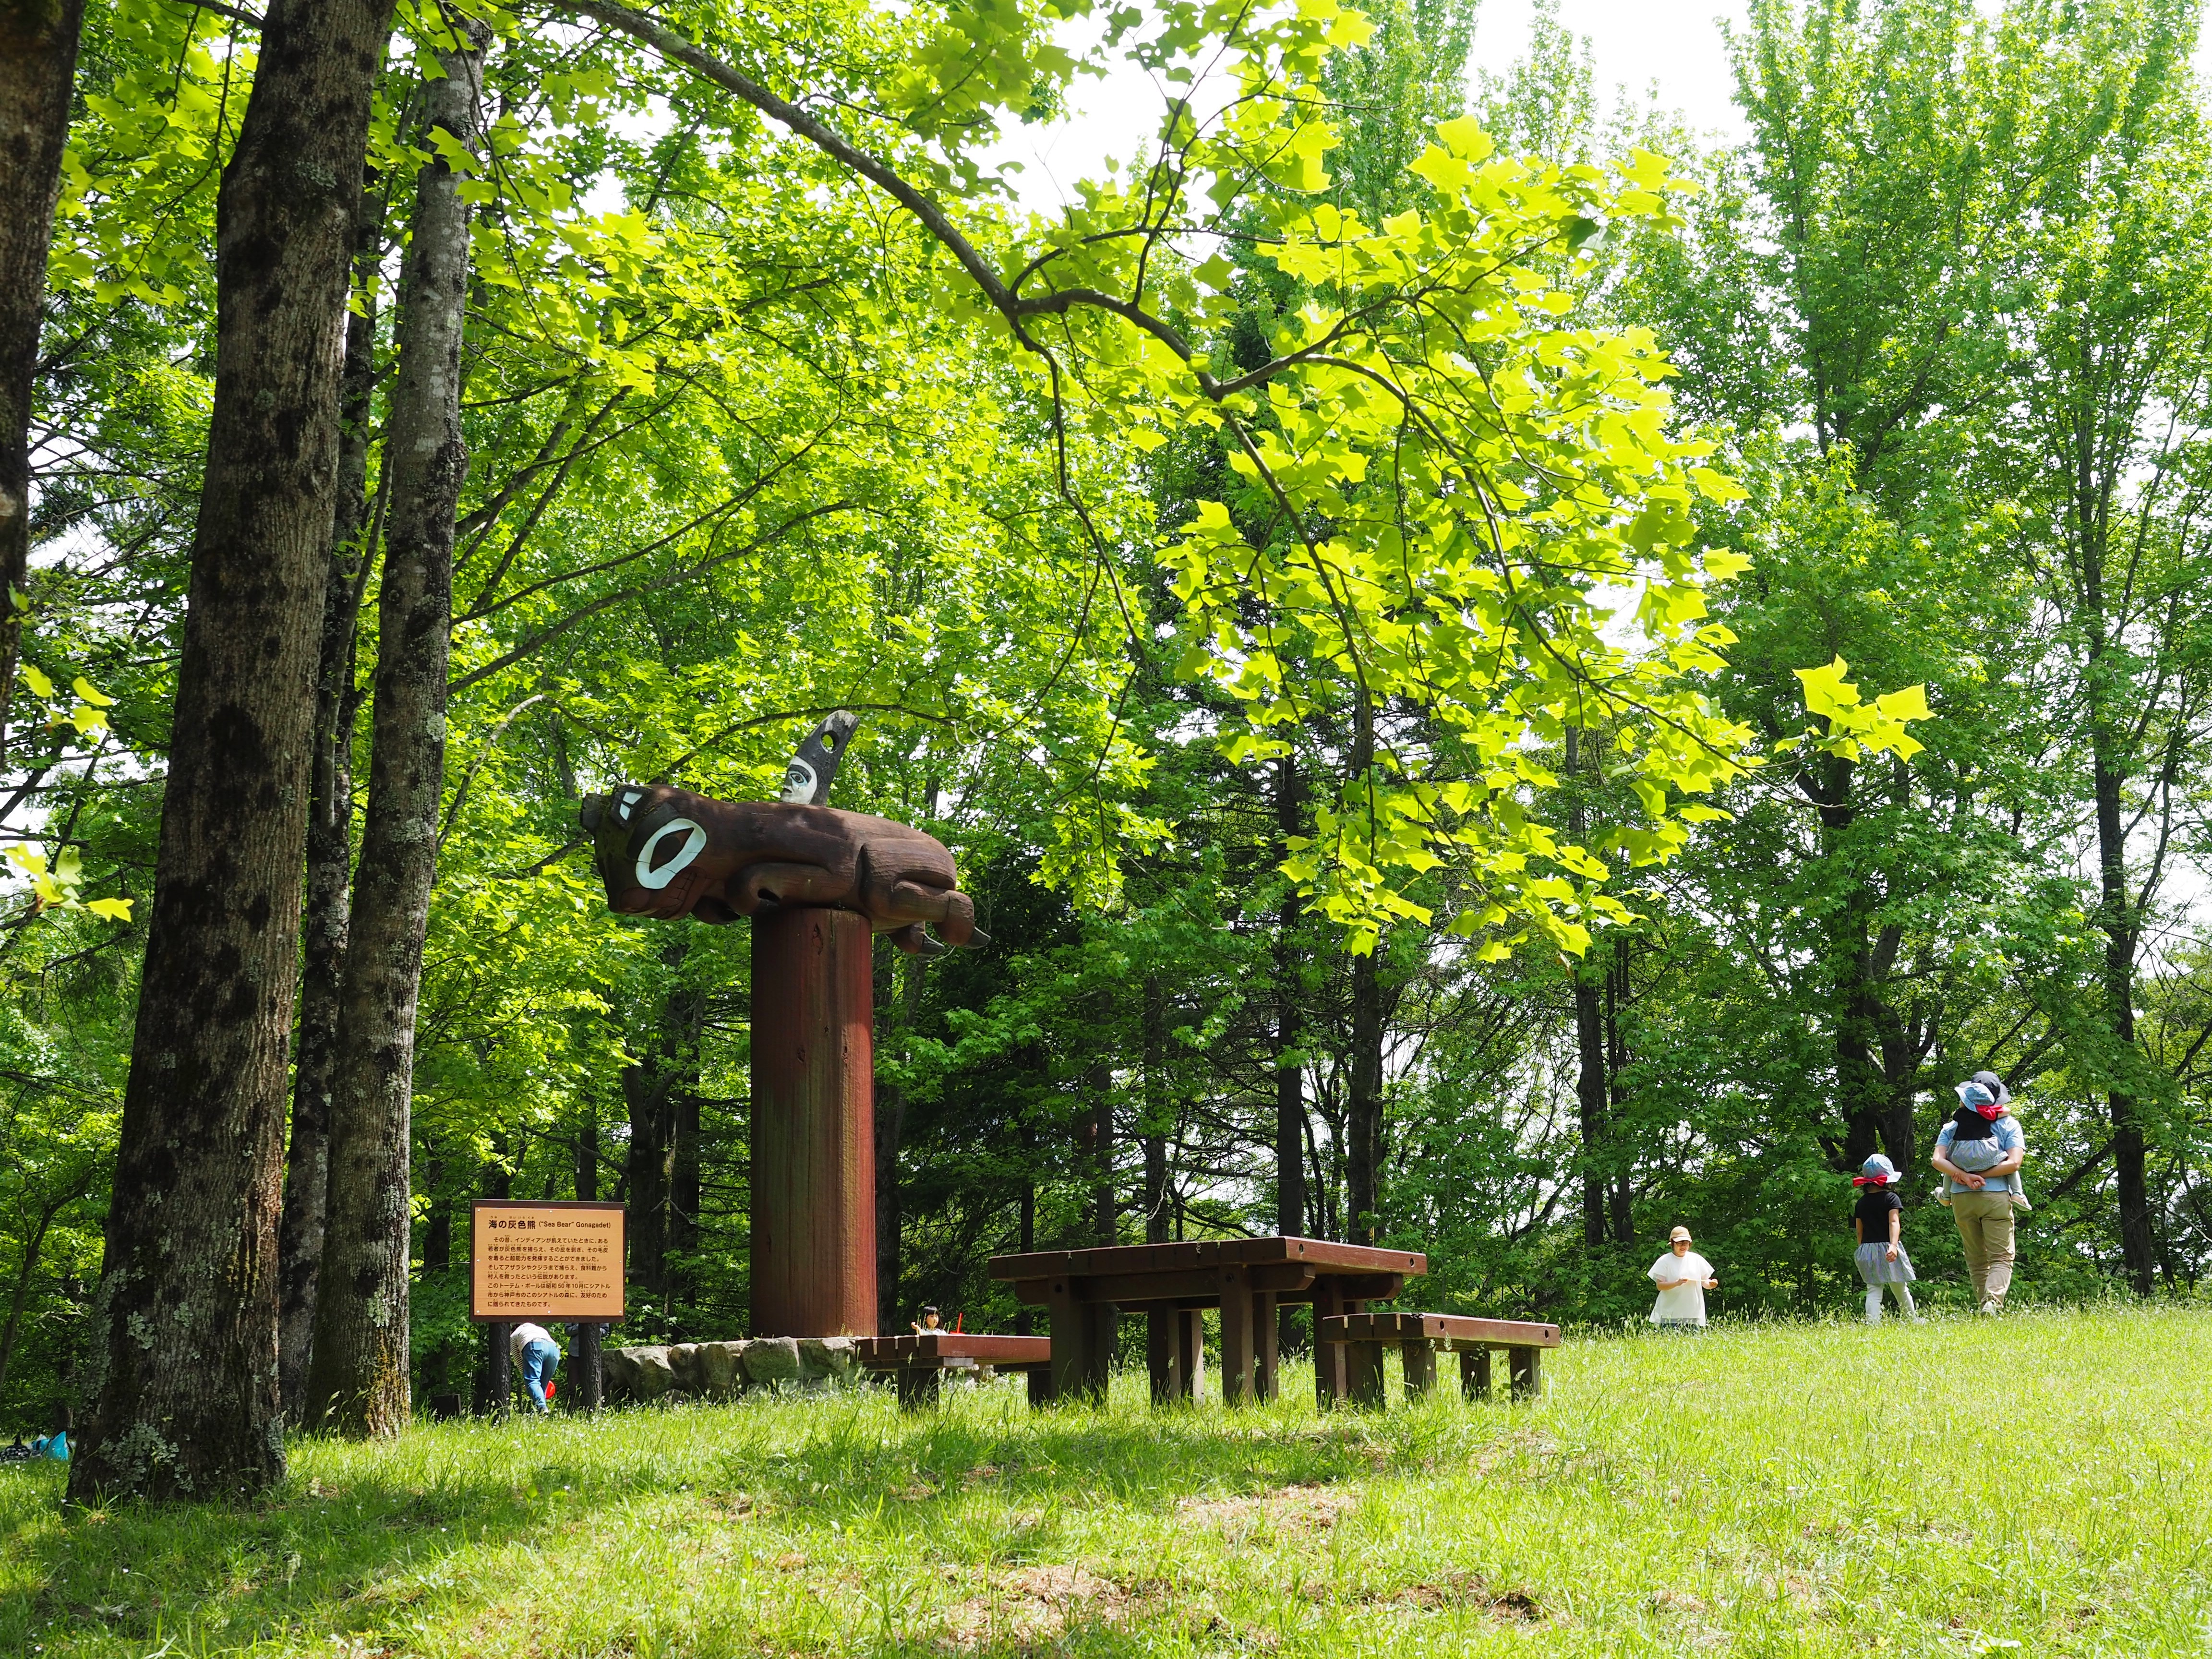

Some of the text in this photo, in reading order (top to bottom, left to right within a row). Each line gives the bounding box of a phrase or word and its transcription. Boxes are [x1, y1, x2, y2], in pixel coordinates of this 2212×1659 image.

[488, 1219, 536, 1229] 海の灰色熊
